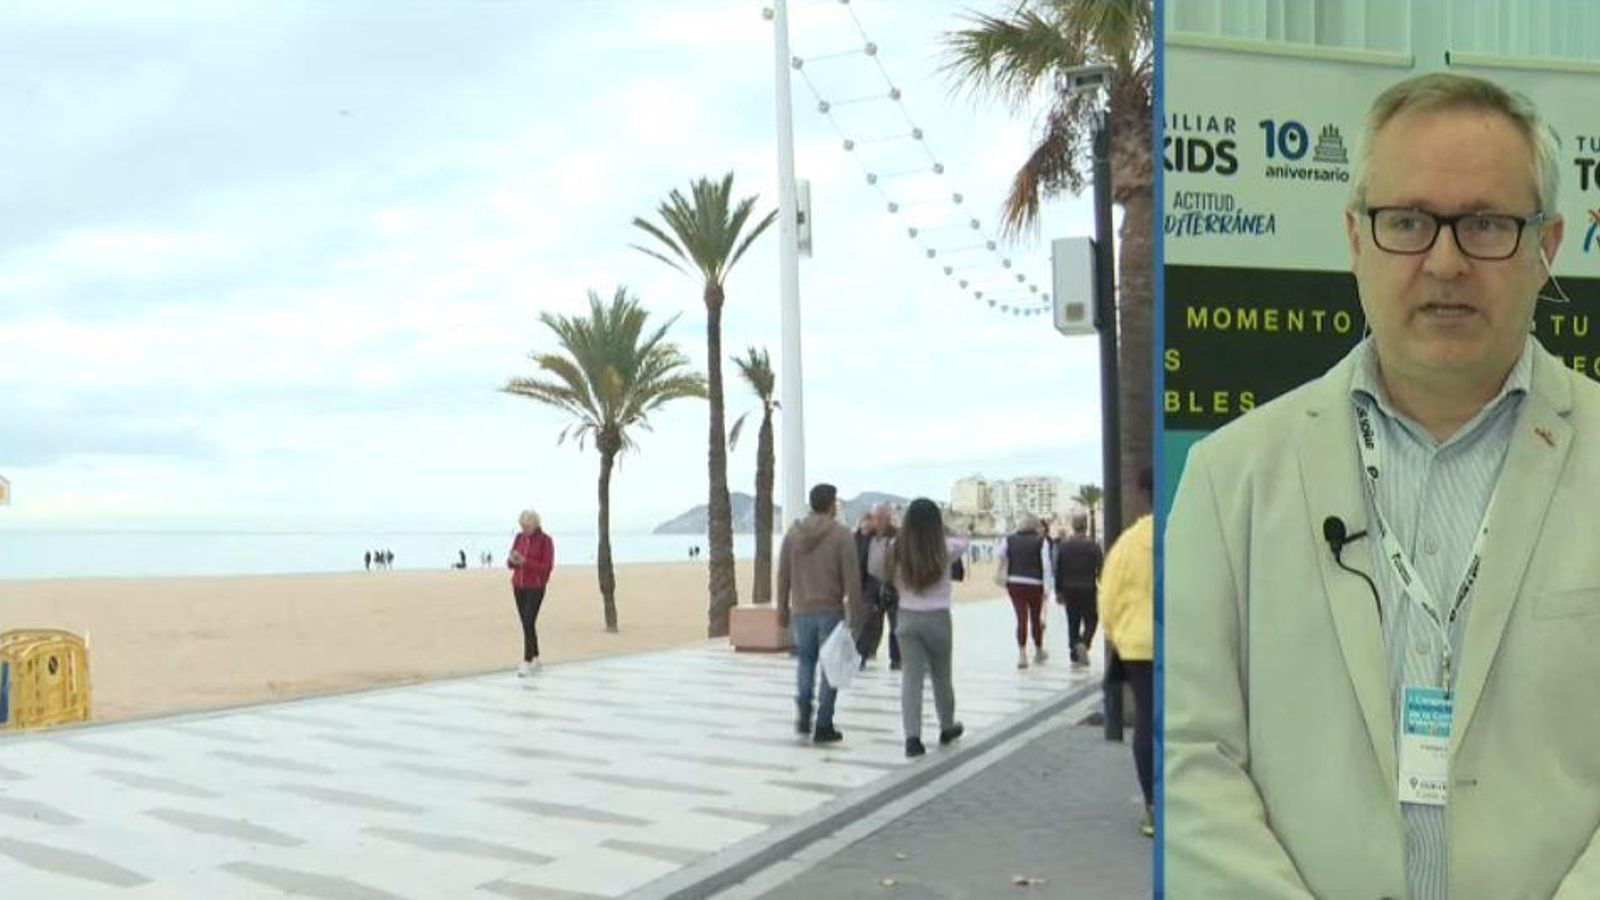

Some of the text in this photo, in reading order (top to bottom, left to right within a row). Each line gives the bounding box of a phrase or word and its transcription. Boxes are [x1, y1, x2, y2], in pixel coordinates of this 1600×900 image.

[1258, 118, 1309, 160] 10
[1265, 163, 1350, 183] aniversario
[1173, 190, 1235, 212] ACTITUD
[1187, 306, 1351, 332] MOMENTO
[1550, 314, 1588, 336] TU
